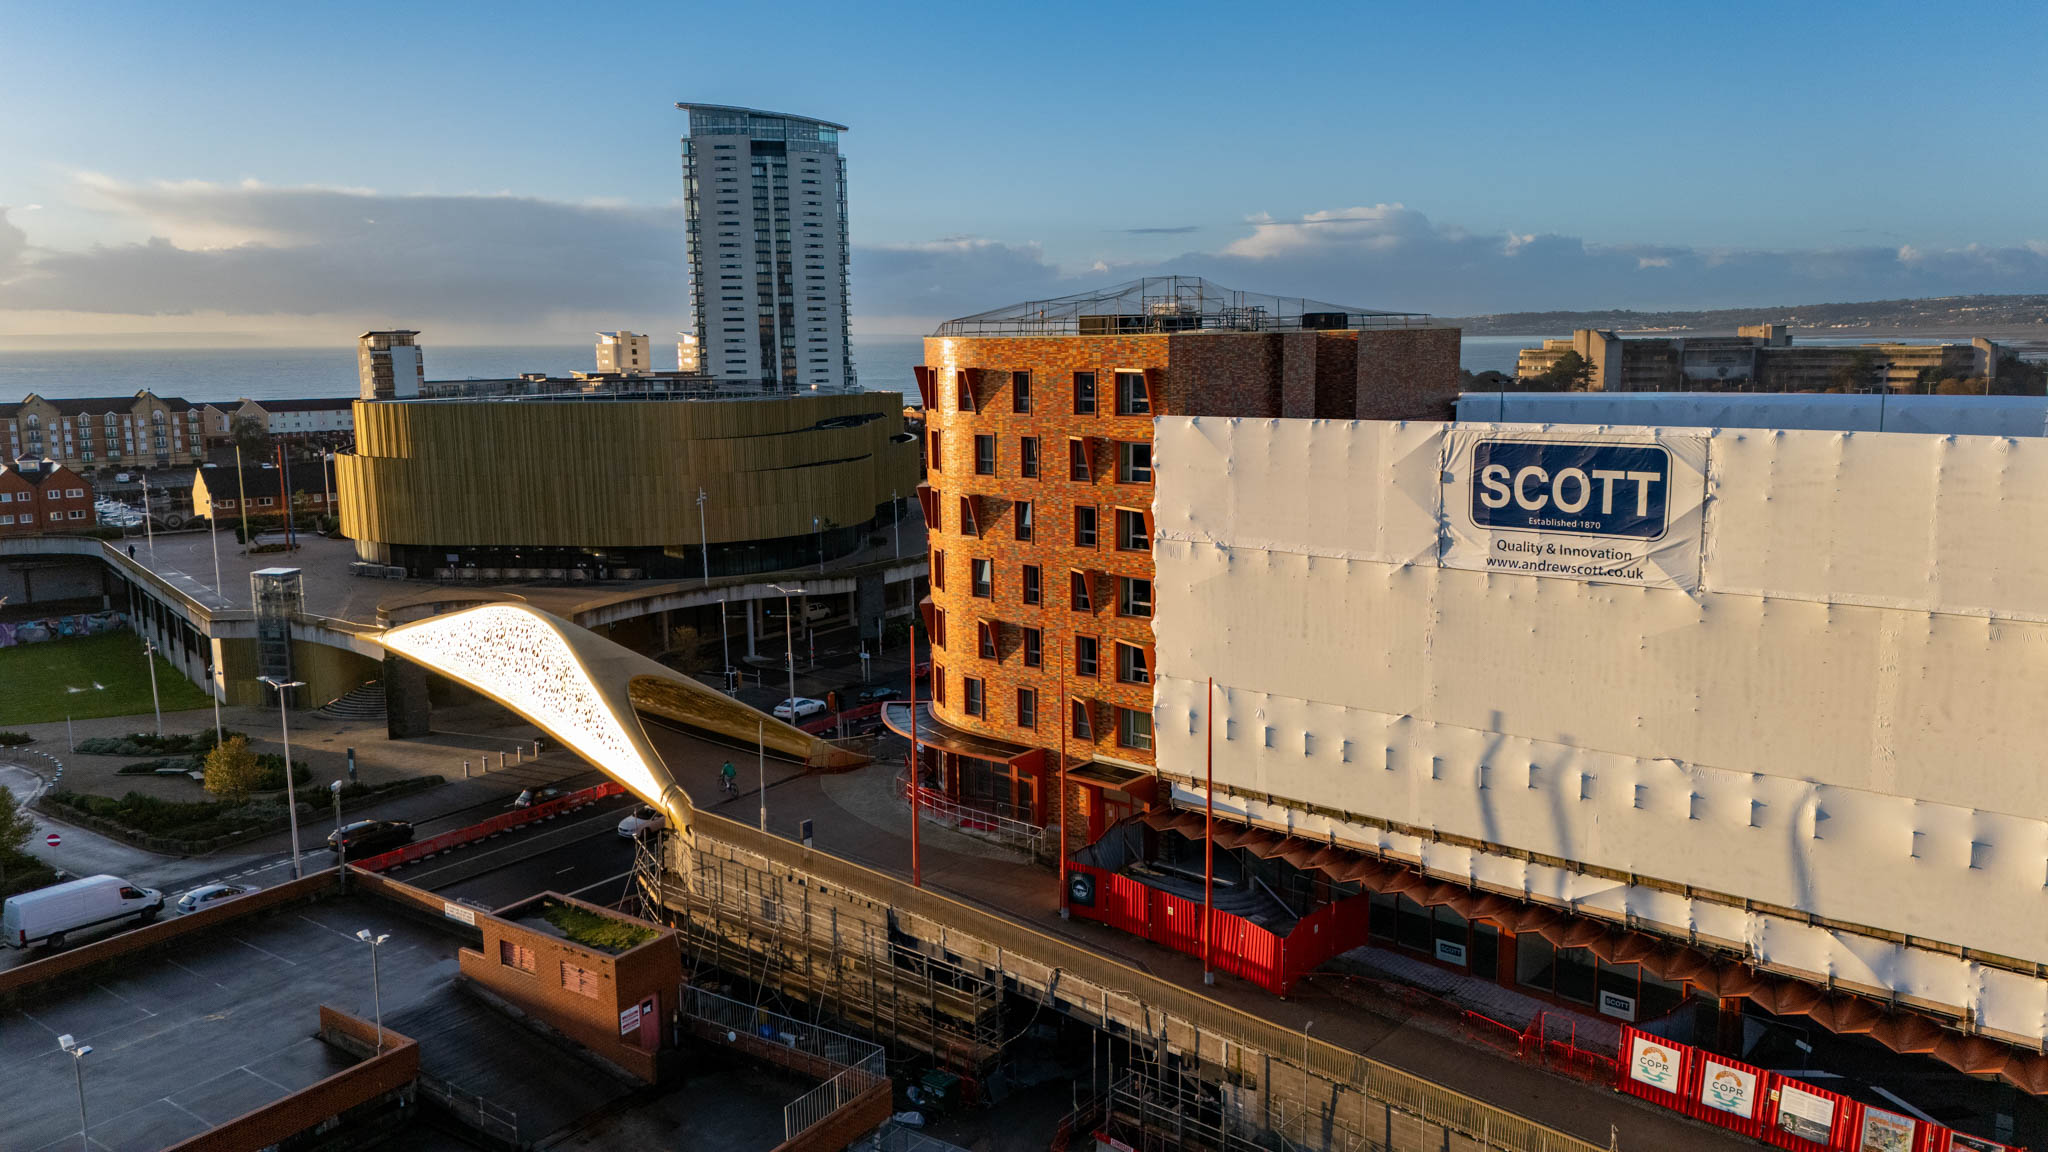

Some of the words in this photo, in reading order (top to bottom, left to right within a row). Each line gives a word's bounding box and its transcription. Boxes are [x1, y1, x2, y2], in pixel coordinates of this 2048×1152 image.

[1480, 464, 1661, 517] SCOTT
[1528, 516, 1577, 528] Established
[1580, 520, 1601, 530] 1870
[1496, 539, 1543, 556] Quality
[1546, 543, 1556, 555] &
[1559, 544, 1632, 561] Innovation
[1486, 557, 1644, 580] www.andrewscott.co.uk
[1606, 997, 1629, 1009] SCOTT
[1640, 1056, 1669, 1073] COPR
[1712, 1081, 1744, 1098] COPR
